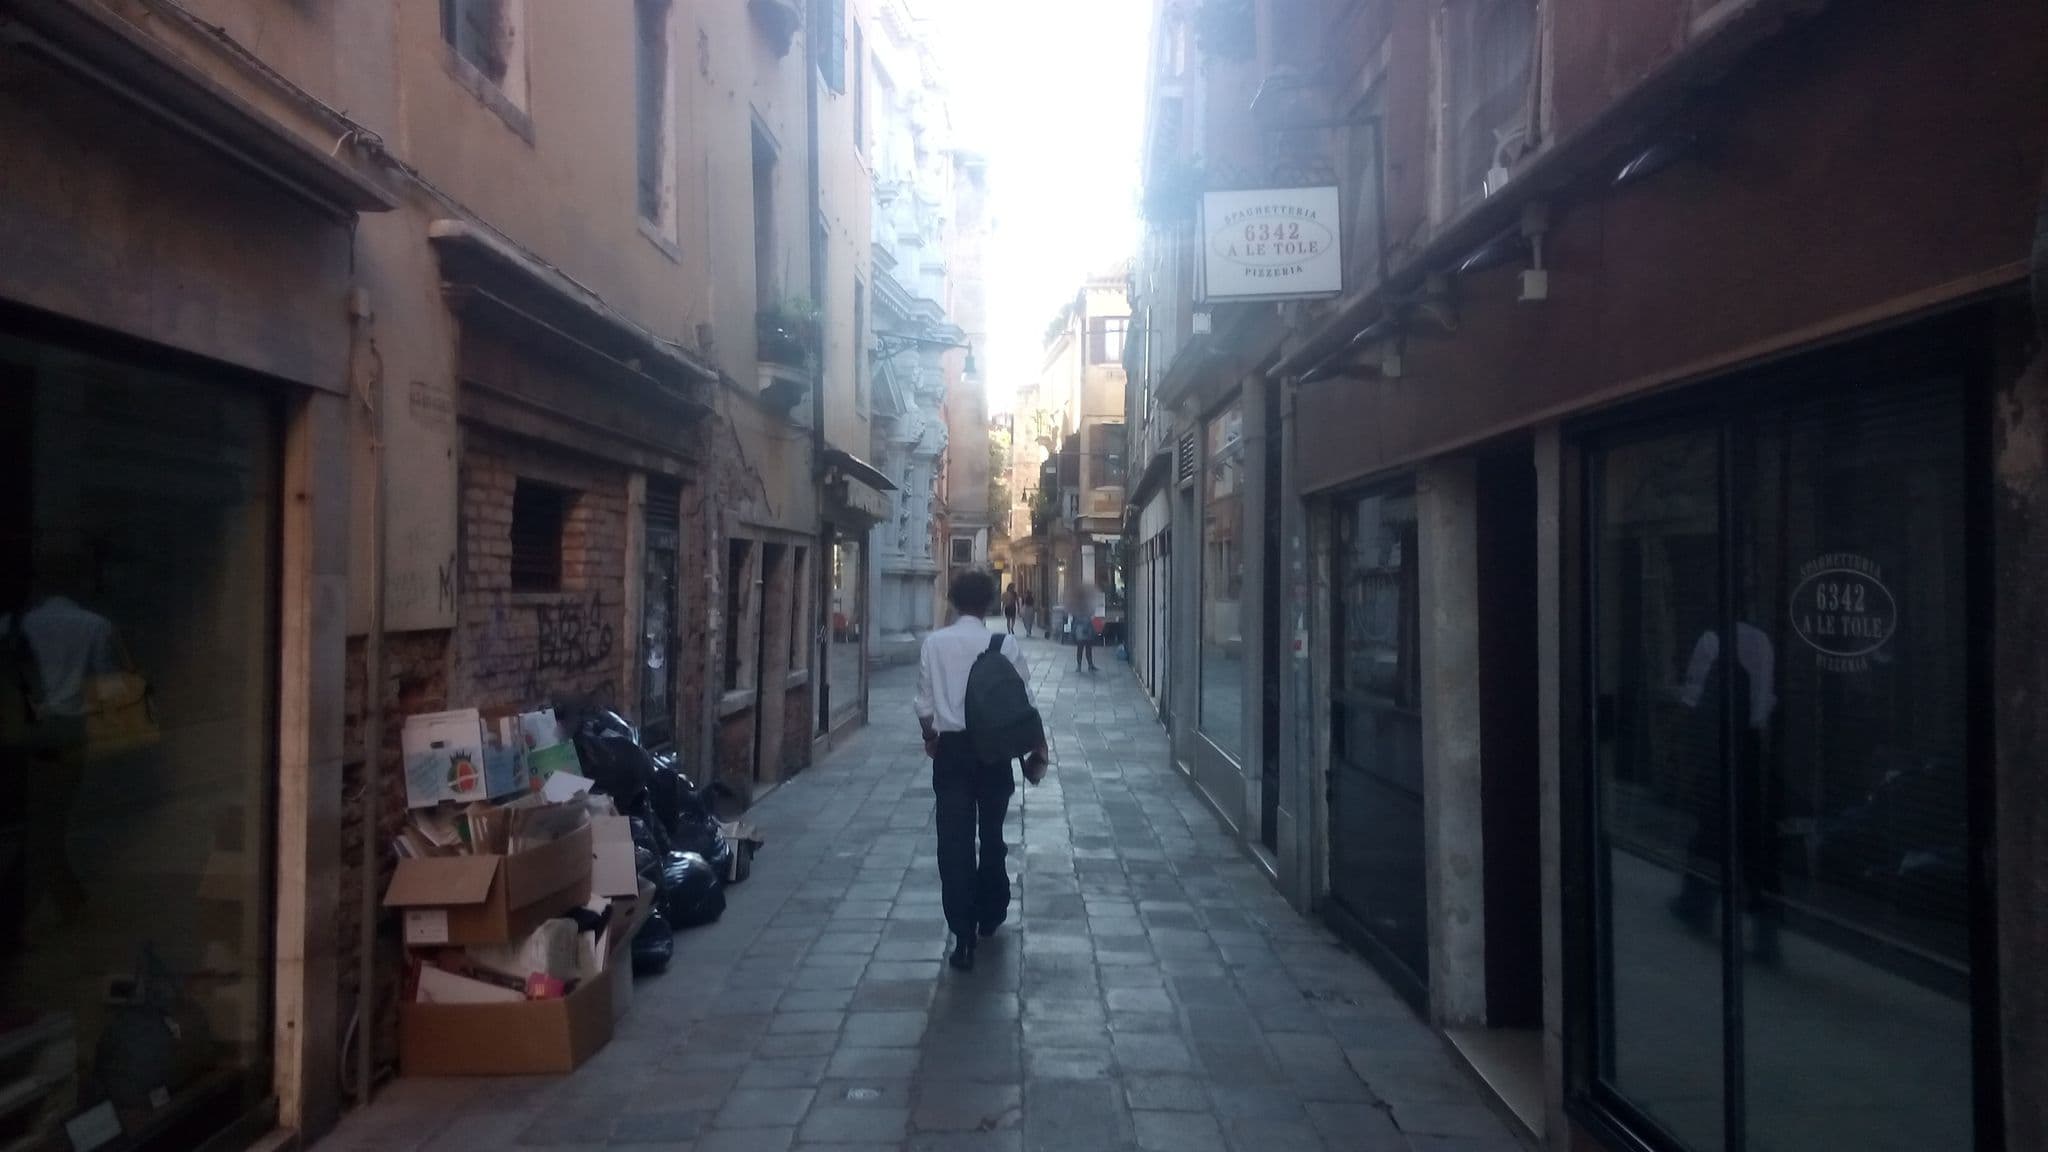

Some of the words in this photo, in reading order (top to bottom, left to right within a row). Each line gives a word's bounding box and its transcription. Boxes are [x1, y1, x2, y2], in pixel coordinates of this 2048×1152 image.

[1224, 205, 1317, 225] SPAGHETTERIA
[1244, 222, 1300, 242] 6342
[1227, 244, 1238, 257] A
[1246, 244, 1266, 256] LE
[1273, 241, 1318, 256] TOLE
[1245, 265, 1303, 278] PIZZERIA
[1816, 583, 1865, 612] 6342
[1803, 615, 1812, 634] A
[1817, 615, 1836, 635] LE
[1841, 616, 1883, 638] TOLE
